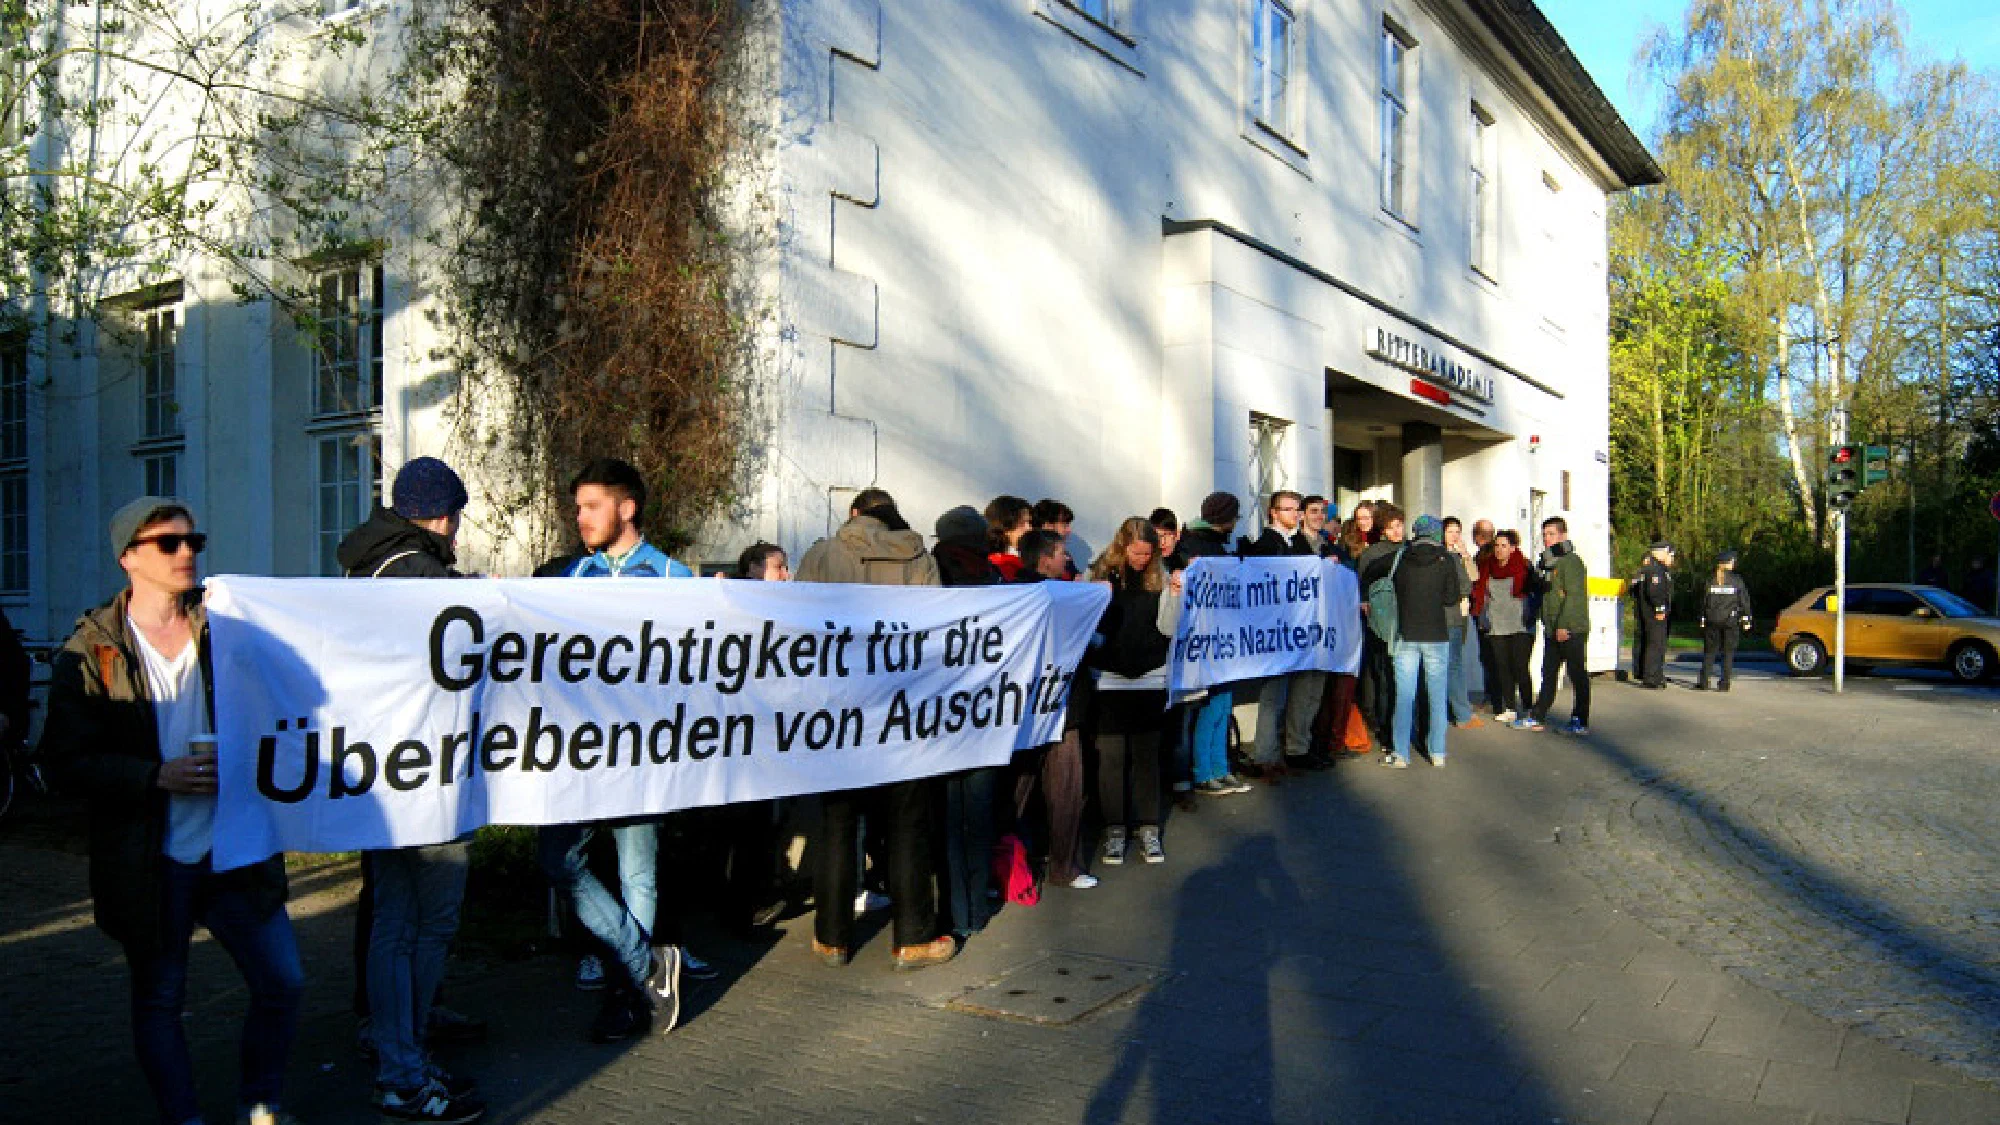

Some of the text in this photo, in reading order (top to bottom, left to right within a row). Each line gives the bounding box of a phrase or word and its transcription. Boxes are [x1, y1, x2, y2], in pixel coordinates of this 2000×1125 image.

[1246, 571, 1280, 607] mit
[1285, 569, 1320, 603] der
[429, 605, 1004, 695] Gerechtigkeit für die
[256, 703, 755, 803] Überlebenden
[775, 705, 865, 753] von
